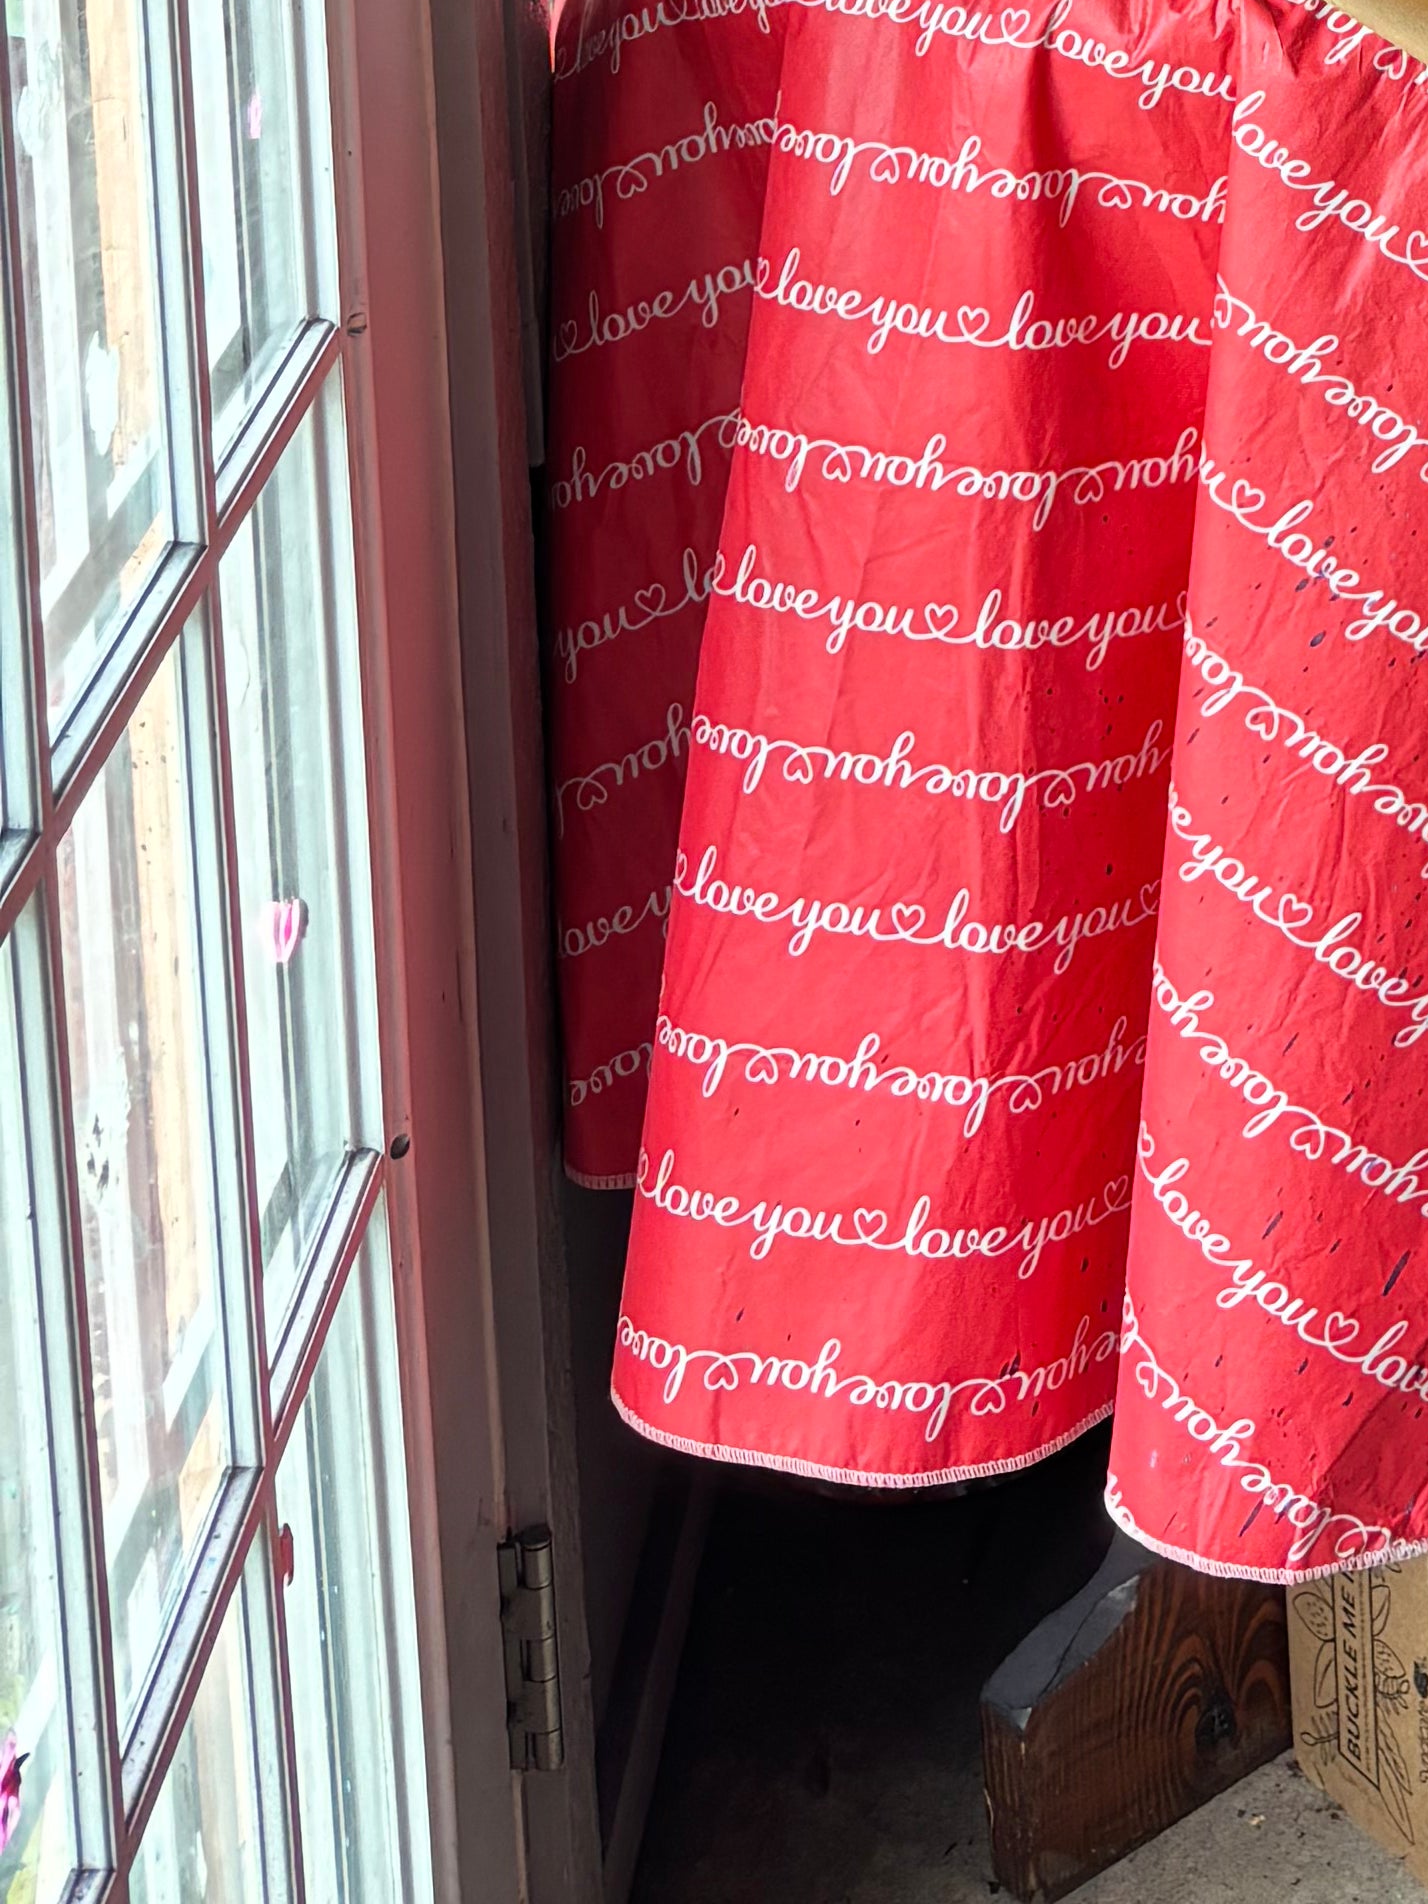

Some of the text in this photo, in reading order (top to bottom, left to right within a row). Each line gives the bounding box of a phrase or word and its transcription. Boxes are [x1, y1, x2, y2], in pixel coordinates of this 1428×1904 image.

[1138, 58, 1237, 110] you
[644, 100, 719, 176] you
[772, 122, 980, 196] you love
[1231, 90, 1312, 186] love
[1297, 177, 1402, 261] you
[980, 166, 1076, 227] love
[584, 290, 676, 348] love
[775, 248, 868, 318] love
[866, 298, 948, 354] you
[1009, 289, 1103, 351] love
[1100, 311, 1202, 369] you
[1231, 304, 1339, 384] you
[608, 430, 702, 486] love
[735, 412, 808, 492] love
[857, 432, 948, 491] you
[1325, 376, 1419, 473] love
[950, 468, 1057, 531] love
[1266, 500, 1361, 600] love
[731, 545, 830, 619] love
[827, 595, 919, 652] you
[977, 589, 1073, 649] love
[616, 702, 691, 784] you
[691, 715, 768, 794] love
[824, 731, 916, 788] you
[1283, 718, 1389, 794] you
[925, 772, 1028, 833] love
[696, 844, 789, 921] love
[787, 898, 881, 956] you
[945, 887, 1043, 955] love
[1040, 902, 1136, 974] you
[1179, 834, 1274, 905] you
[1313, 912, 1408, 1004] love
[657, 1015, 730, 1098] love
[789, 1032, 881, 1091] you
[1049, 1016, 1135, 1091] you
[1200, 1034, 1290, 1138] love
[890, 1068, 991, 1138] love
[650, 1148, 1098, 1280] love you love you
[1153, 1157, 1232, 1262] love
[1217, 1256, 1319, 1332] you
[619, 1314, 686, 1404] love
[748, 1337, 842, 1397] you
[852, 1372, 952, 1442] love
[1160, 1389, 1254, 1468] you
[1339, 1586, 1358, 1639] ME
[1342, 1639, 1362, 1762] BUCKLE
